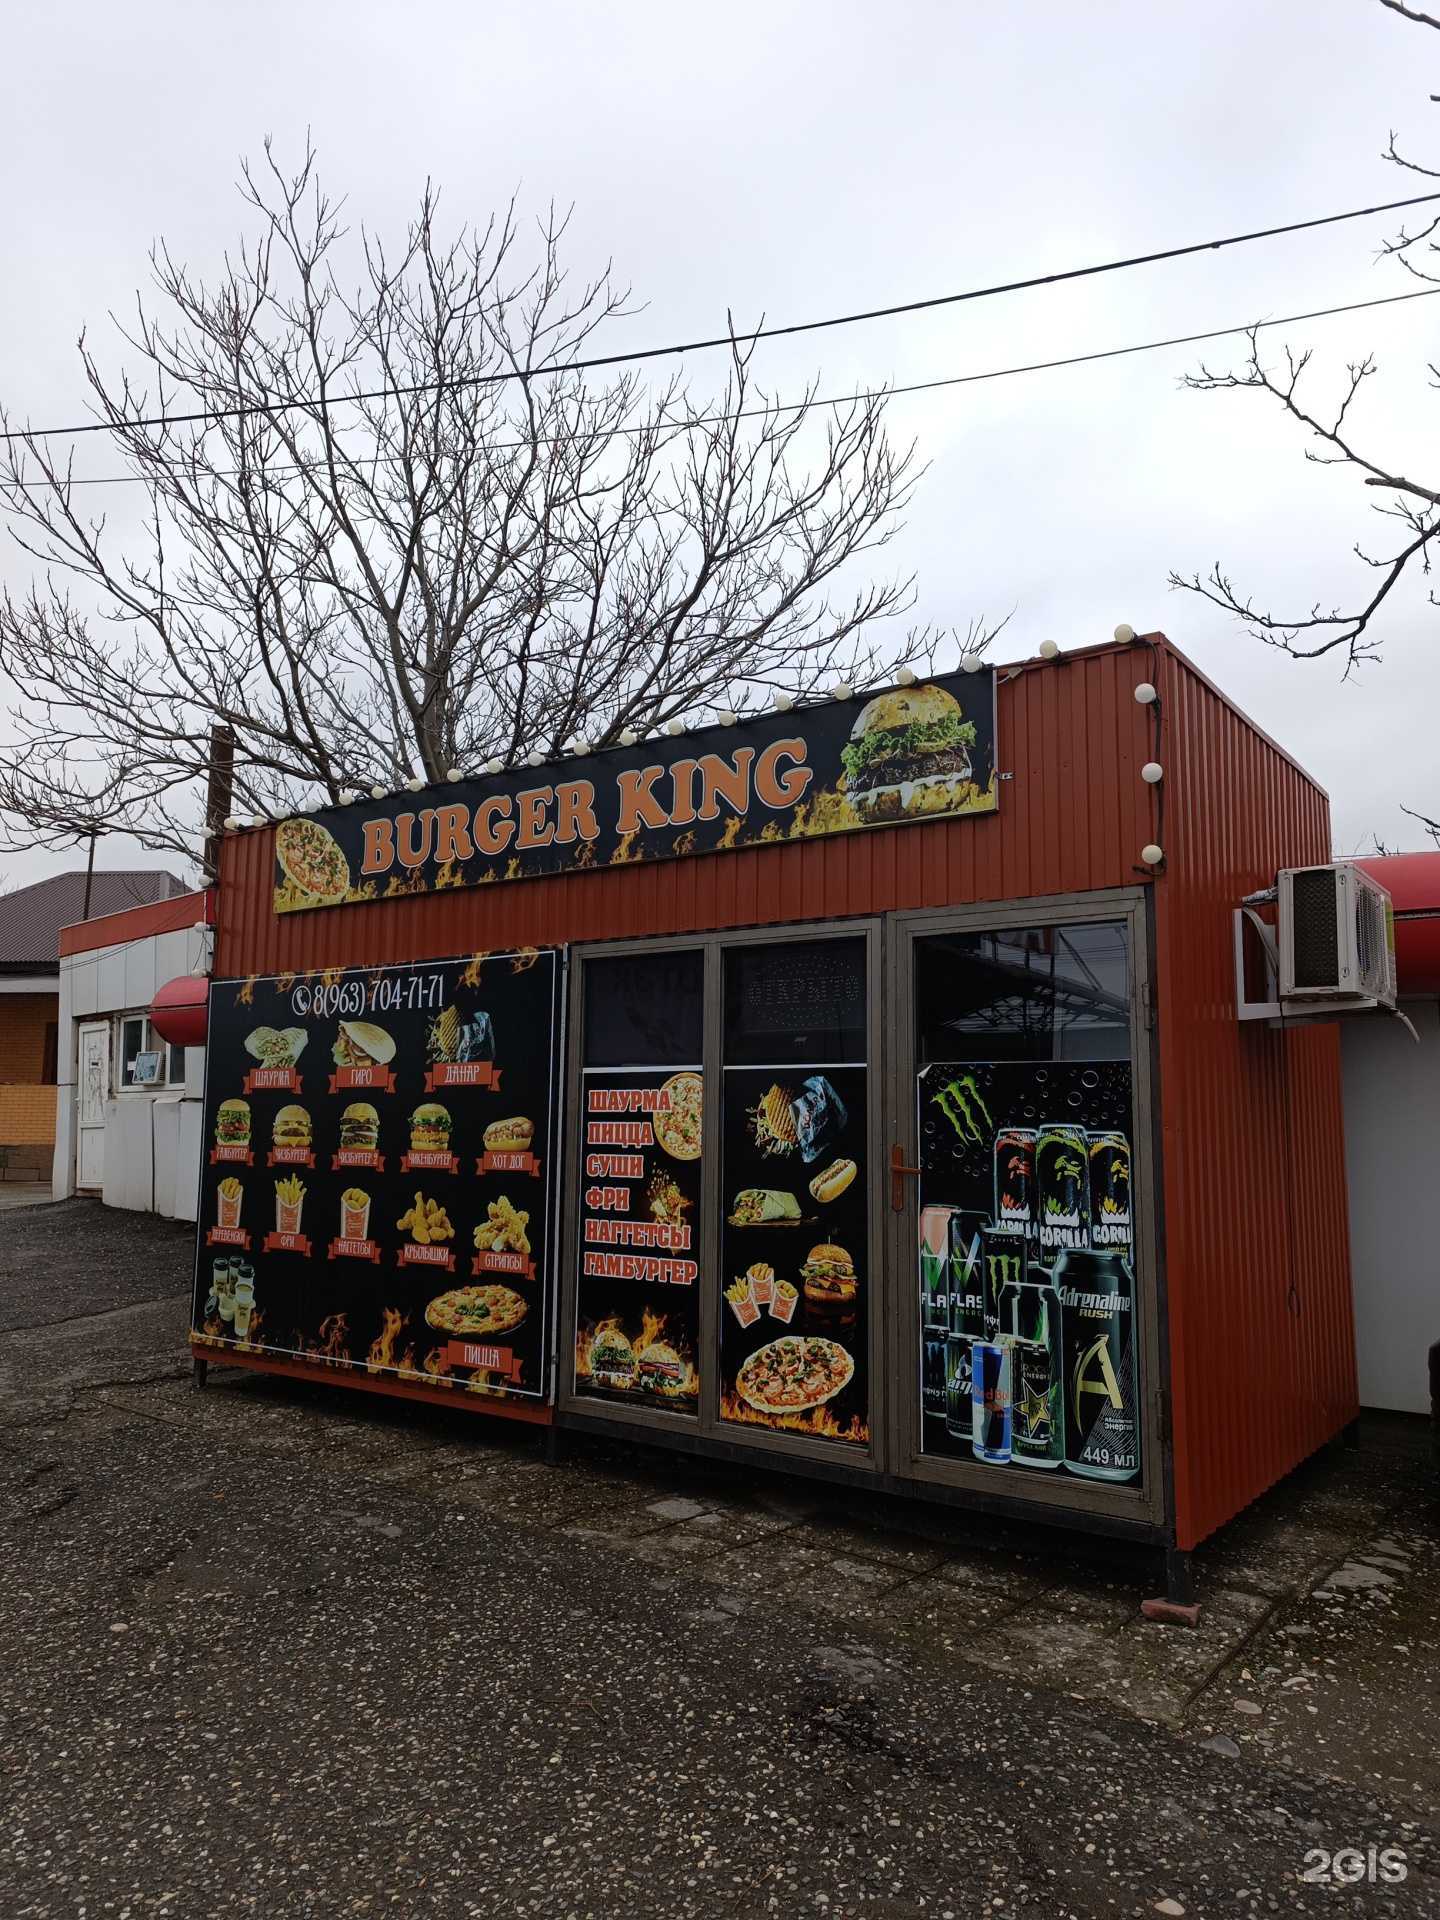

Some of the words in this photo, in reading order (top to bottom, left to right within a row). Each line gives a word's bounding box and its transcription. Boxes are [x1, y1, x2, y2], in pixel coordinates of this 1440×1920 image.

[360, 779, 600, 876] BURGER
[615, 736, 814, 835] KING
[313, 980, 366, 1018] 8(963)
[370, 974, 445, 1012] 704-71-71
[255, 1070, 290, 1086] ШАУРМА
[350, 1069, 373, 1086] ГИРО
[444, 1065, 481, 1083] ДАНАР
[588, 1089, 672, 1113] ШАУРМА
[587, 1121, 654, 1148] ПИЦЦА
[216, 1147, 248, 1161] ГАМБУРГЕР
[408, 1152, 452, 1166] ЧИКЕНБУРГЕР
[492, 1154, 507, 1168] ХОТ
[508, 1154, 526, 1169] ДОГ
[586, 1153, 644, 1179] СУШИ
[585, 1186, 631, 1212] ФРИ
[280, 1235, 295, 1249] ФРИ
[584, 1218, 692, 1250] НАГГЕТСЫ
[1039, 1225, 1088, 1248] GORILLA
[338, 1241, 371, 1256] НАГГЕТСЫ
[403, 1244, 449, 1262] КРЫЛЫШКИ
[484, 1254, 523, 1270] СТРИПСЫ
[583, 1252, 698, 1286] ГАМБУРГЕР
[1057, 1285, 1131, 1312] Adrenaline
[1079, 1308, 1113, 1320] RUSH
[464, 1344, 500, 1368] ПИЦЦА
[1083, 1446, 1110, 1464] 449
